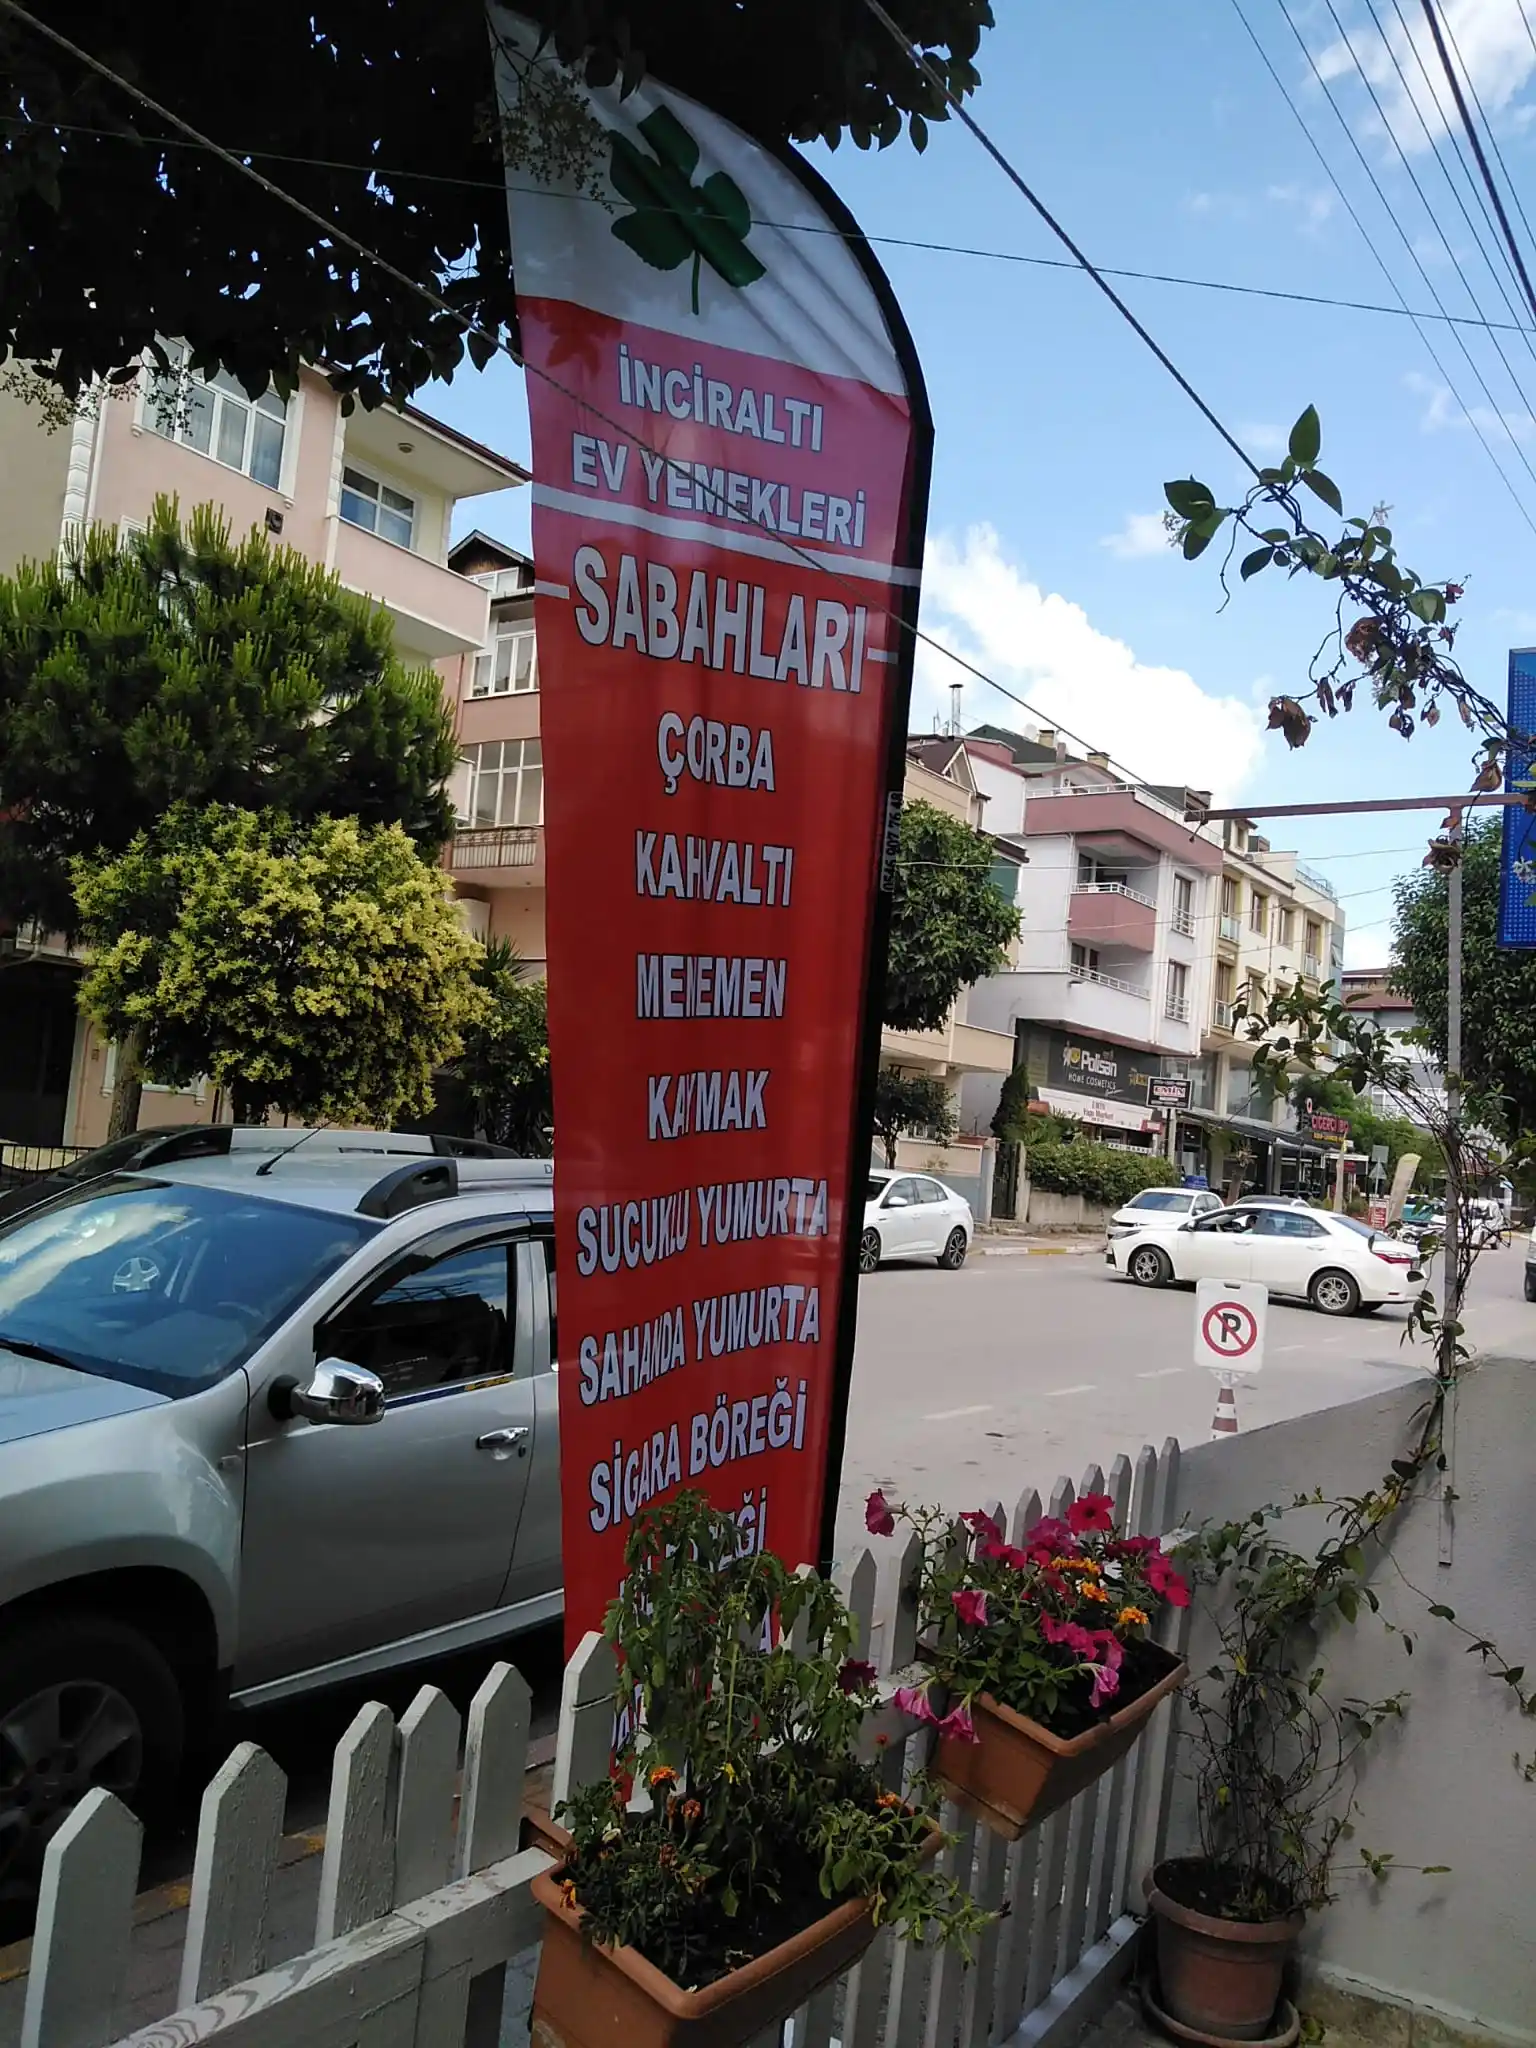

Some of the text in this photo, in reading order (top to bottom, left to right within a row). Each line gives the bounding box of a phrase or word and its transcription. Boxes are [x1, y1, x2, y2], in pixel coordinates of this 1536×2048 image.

[618, 343, 823, 452] İNCİRALTI
[571, 432, 867, 549] EV YEMEKLERİ
[572, 544, 869, 693] SABAHLARI
[656, 710, 776, 794] ÇORBA
[635, 829, 795, 907] KAHVALTI
[636, 953, 787, 1019] MENEMEN
[647, 1068, 773, 1141] KAYMAK
[1068, 1072, 1085, 1084] HOME
[1086, 1075, 1117, 1090] COSMETICS
[1080, 1049, 1118, 1077] Polisan
[576, 1176, 829, 1277] SUCUKLU YUMURTA
[578, 1284, 820, 1406] SAHANDA YUMURTA
[588, 1423, 682, 1533] SİGARA
[689, 1375, 809, 1477] BÖREĞİ
